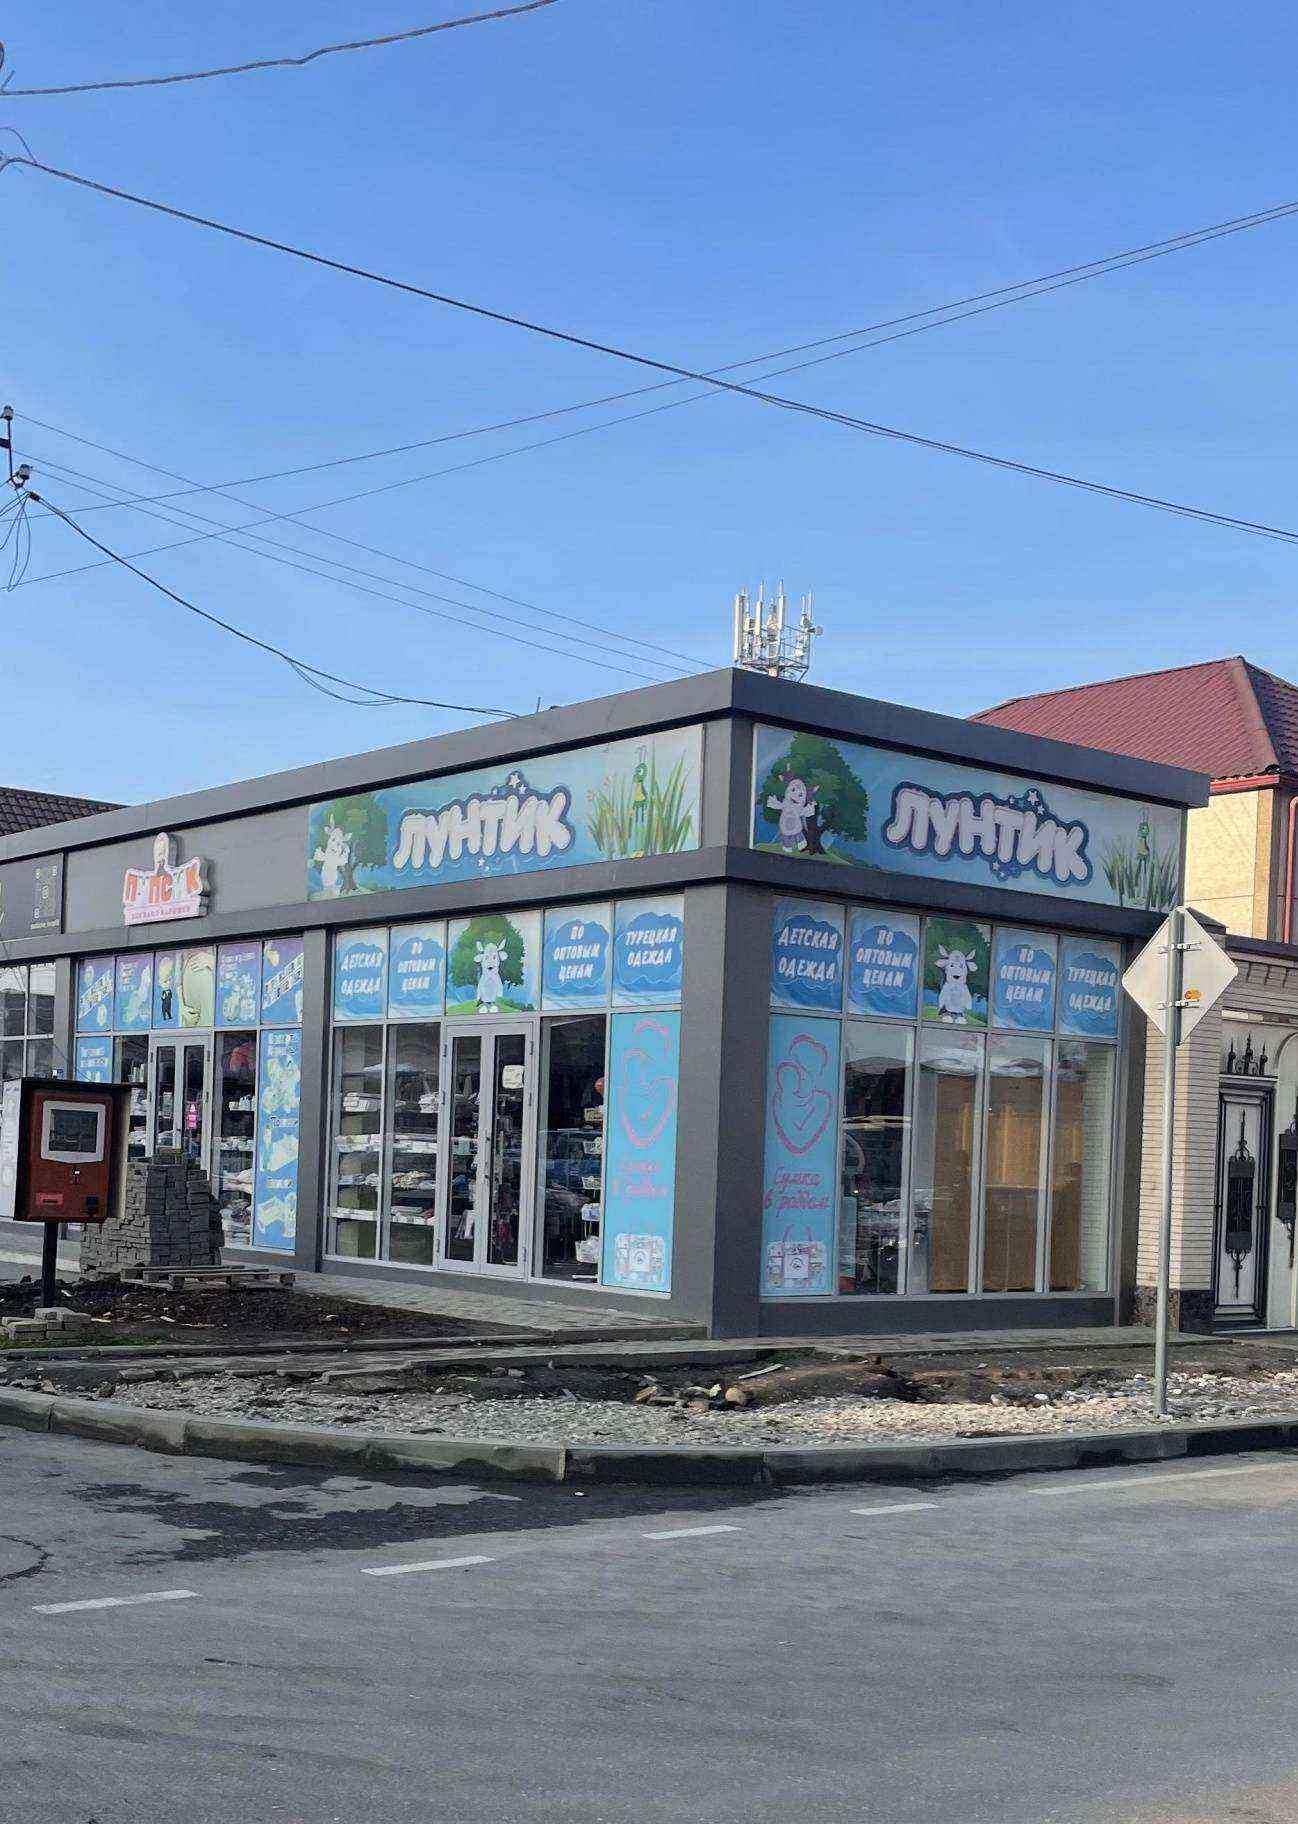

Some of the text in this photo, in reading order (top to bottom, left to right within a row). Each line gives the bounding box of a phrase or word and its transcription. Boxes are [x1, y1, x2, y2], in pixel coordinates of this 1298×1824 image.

[393, 792, 571, 869] ЛУНТИК
[887, 787, 1088, 881] ЛУНТИК
[625, 927, 677, 947] ТУРЕЦКАЯ
[777, 926, 838, 950] ДЕТСКАЯ
[876, 929, 894, 946] ПО
[341, 951, 383, 971] ДЕТСКАЯ
[553, 943, 600, 961] ОПТОВЫМ
[627, 948, 672, 966] ОДЕЖДА
[856, 947, 913, 968] ОПТОВЫМ
[558, 963, 594, 982] ЦЕНАМ
[778, 957, 836, 981] ОДЕЖДА
[863, 969, 904, 988] ЦЕНАМ
[1000, 965, 1051, 985] ОПТОВЫМ
[341, 977, 380, 996] ОДЕЖДА
[1005, 984, 1044, 1003] ЦЕНАМ
[1069, 993, 1112, 1013] ОДЕЖДА
